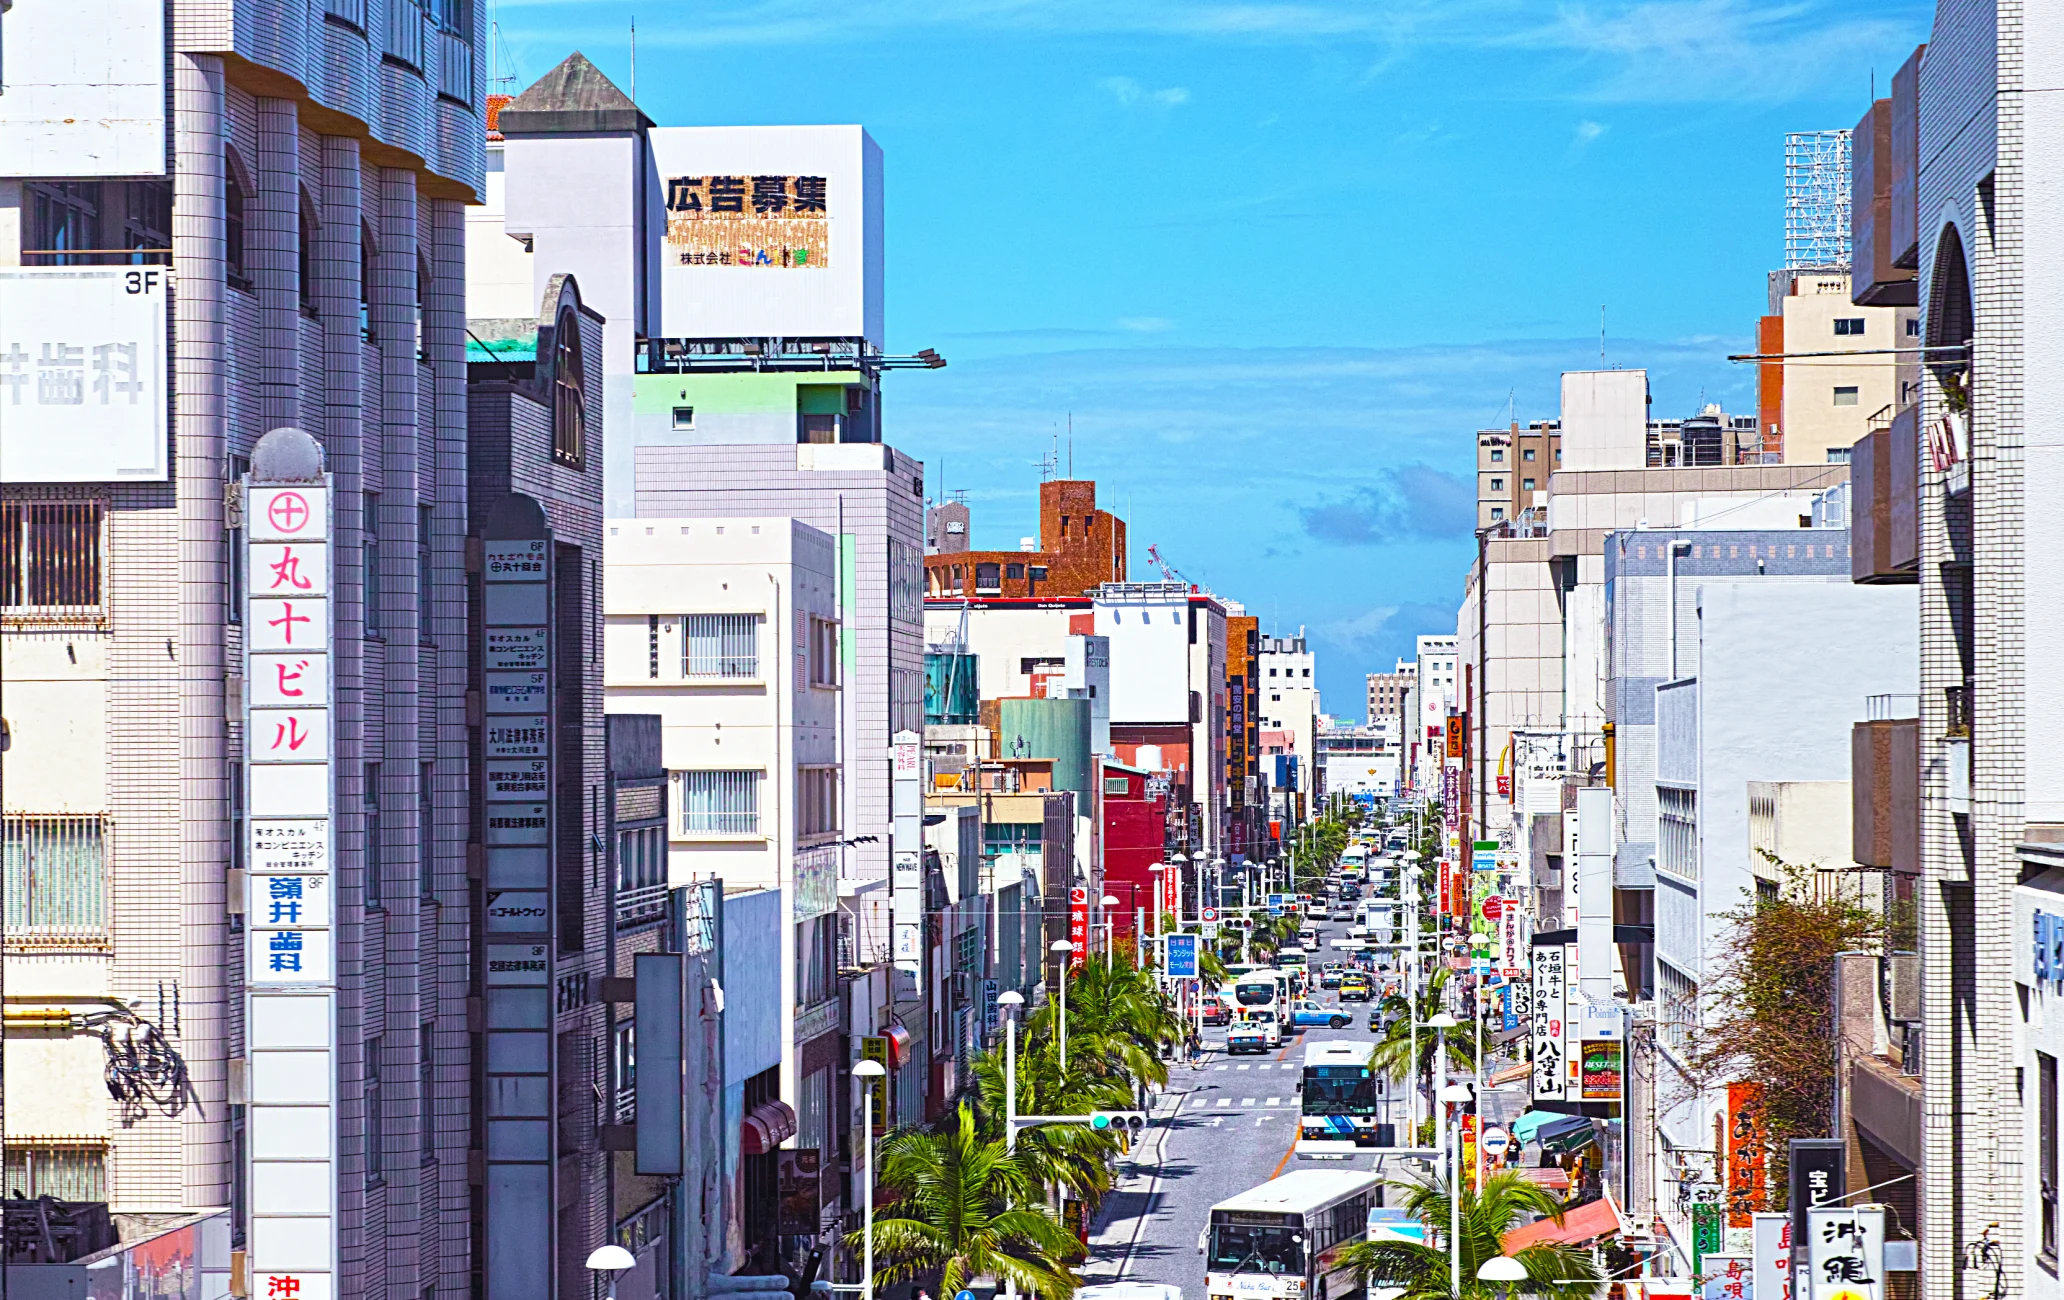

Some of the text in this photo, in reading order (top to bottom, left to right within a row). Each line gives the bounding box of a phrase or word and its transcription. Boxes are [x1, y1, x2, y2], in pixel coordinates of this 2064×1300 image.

[666, 176, 827, 213] 広告募集
[680, 251, 732, 265] 株式会社
[125, 271, 159, 295] 3F
[530, 541, 545, 552] 6F
[502, 562, 542, 572] 丸十商会
[267, 546, 312, 752] 丸十ビル
[530, 673, 545, 683] 5F
[489, 728, 546, 744] 大川法律事務所
[531, 762, 545, 771] 5F
[1446, 778, 1457, 823] ホテル山の内
[291, 851, 325, 859] キッチン
[308, 876, 324, 889] 3F
[1071, 910, 1084, 968] 琉球銀行
[531, 946, 545, 956] 3F
[1168, 949, 1195, 958] トランジット
[1548, 950, 1562, 999] 石垣牛と
[1535, 951, 1548, 1037] あぐーの専門店
[986, 981, 998, 1025] 山田歯科
[1537, 1040, 1563, 1095] 八重山
[267, 1275, 300, 1300] 沖
[1286, 1280, 1299, 1291] 25
